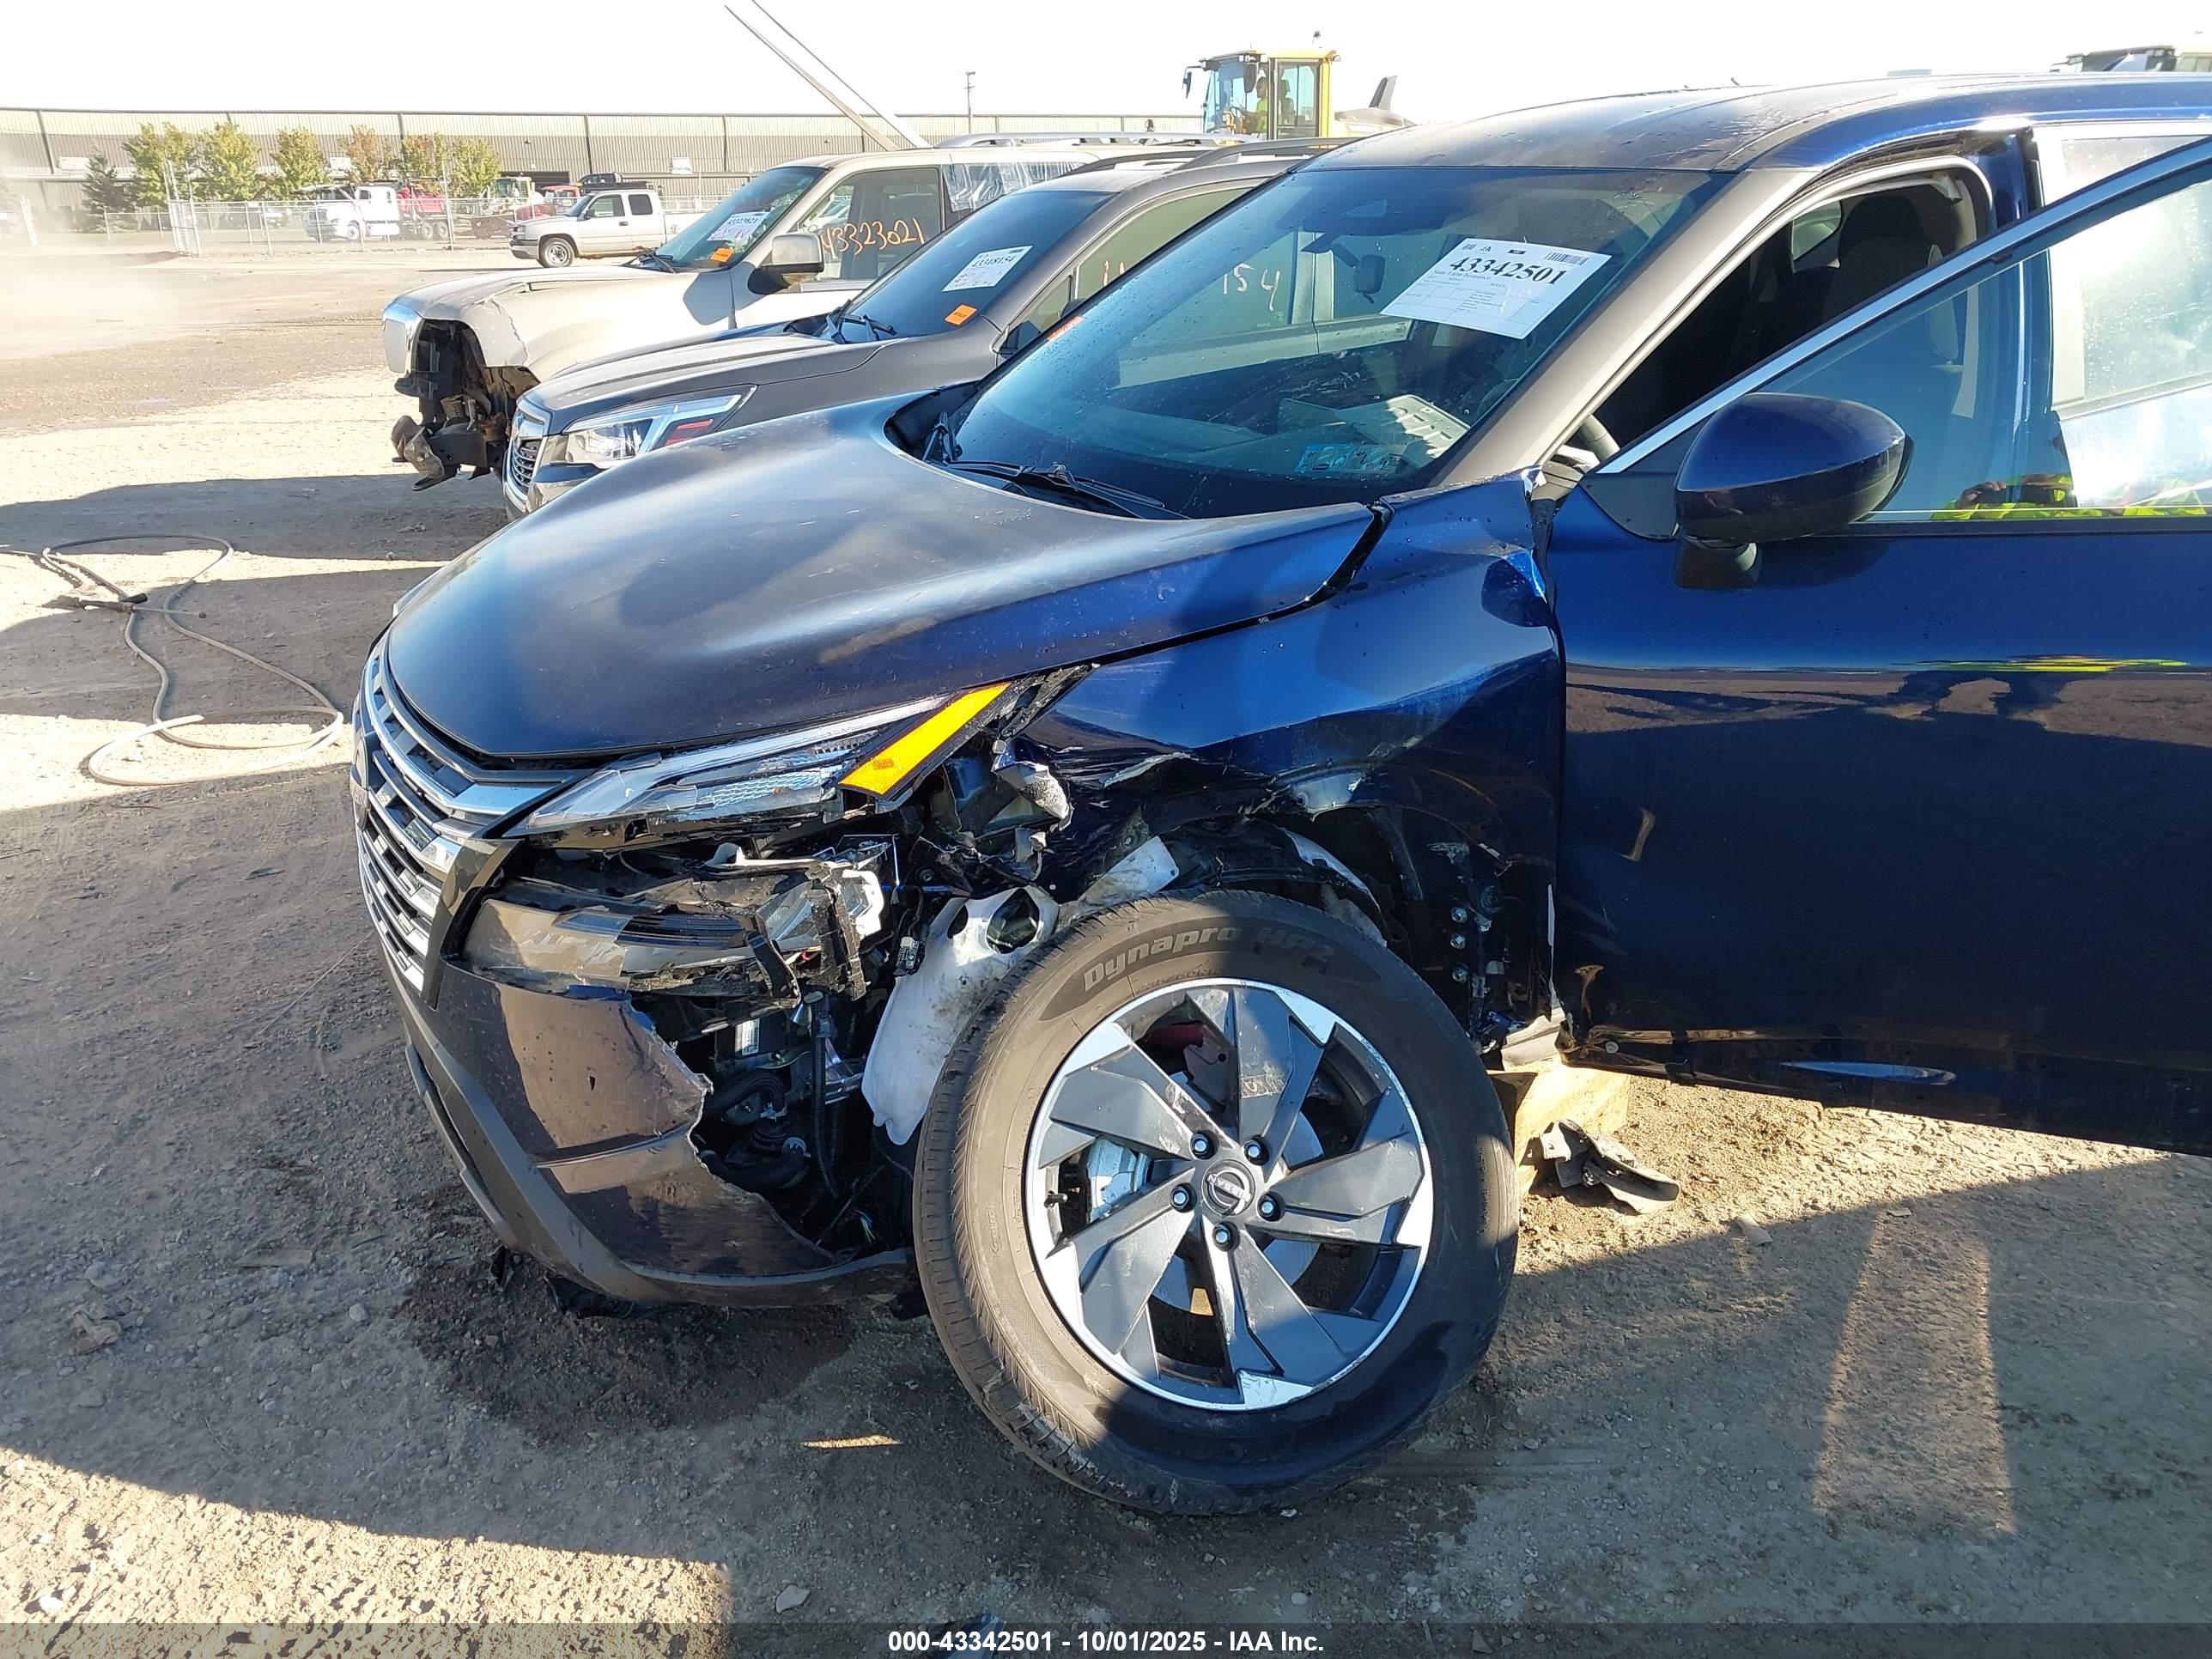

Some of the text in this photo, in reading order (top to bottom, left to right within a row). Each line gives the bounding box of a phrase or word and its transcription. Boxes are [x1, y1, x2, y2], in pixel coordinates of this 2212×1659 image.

[820, 217, 925, 259] 43323021
[1449, 257, 1567, 285] 43342501
[1084, 927, 1243, 991] Dynapro
